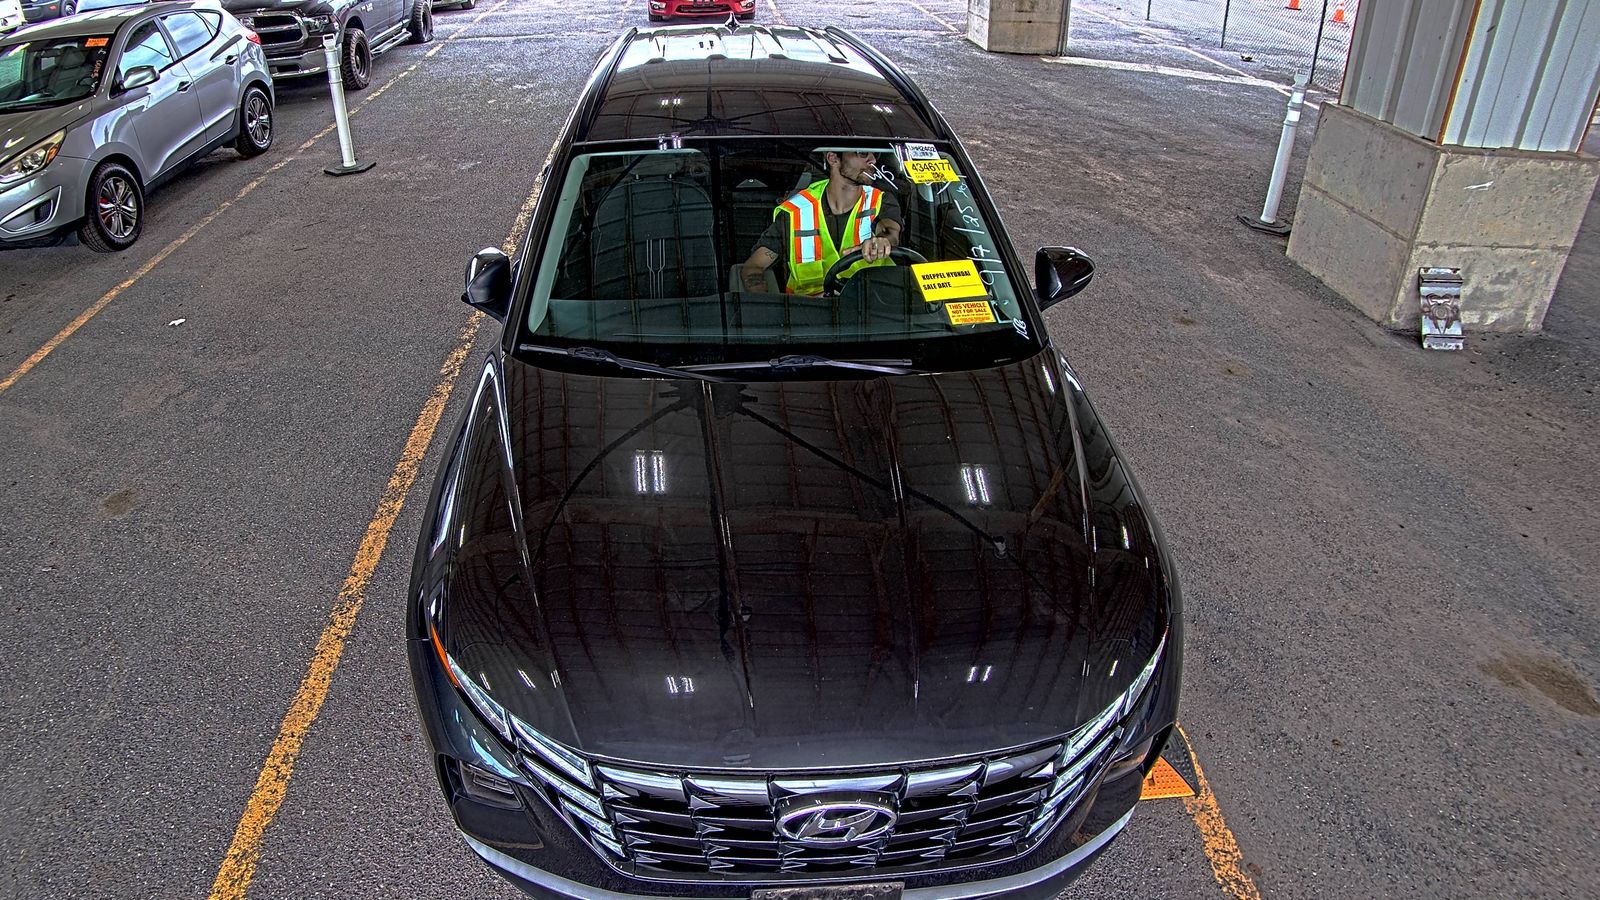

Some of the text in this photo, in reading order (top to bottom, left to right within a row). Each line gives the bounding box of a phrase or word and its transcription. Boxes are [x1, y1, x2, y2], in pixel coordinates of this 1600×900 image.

[912, 163, 951, 172] 4346177
[921, 270, 971, 281] KOEPPEL HYUNDAI
[922, 283, 938, 291] SALE
